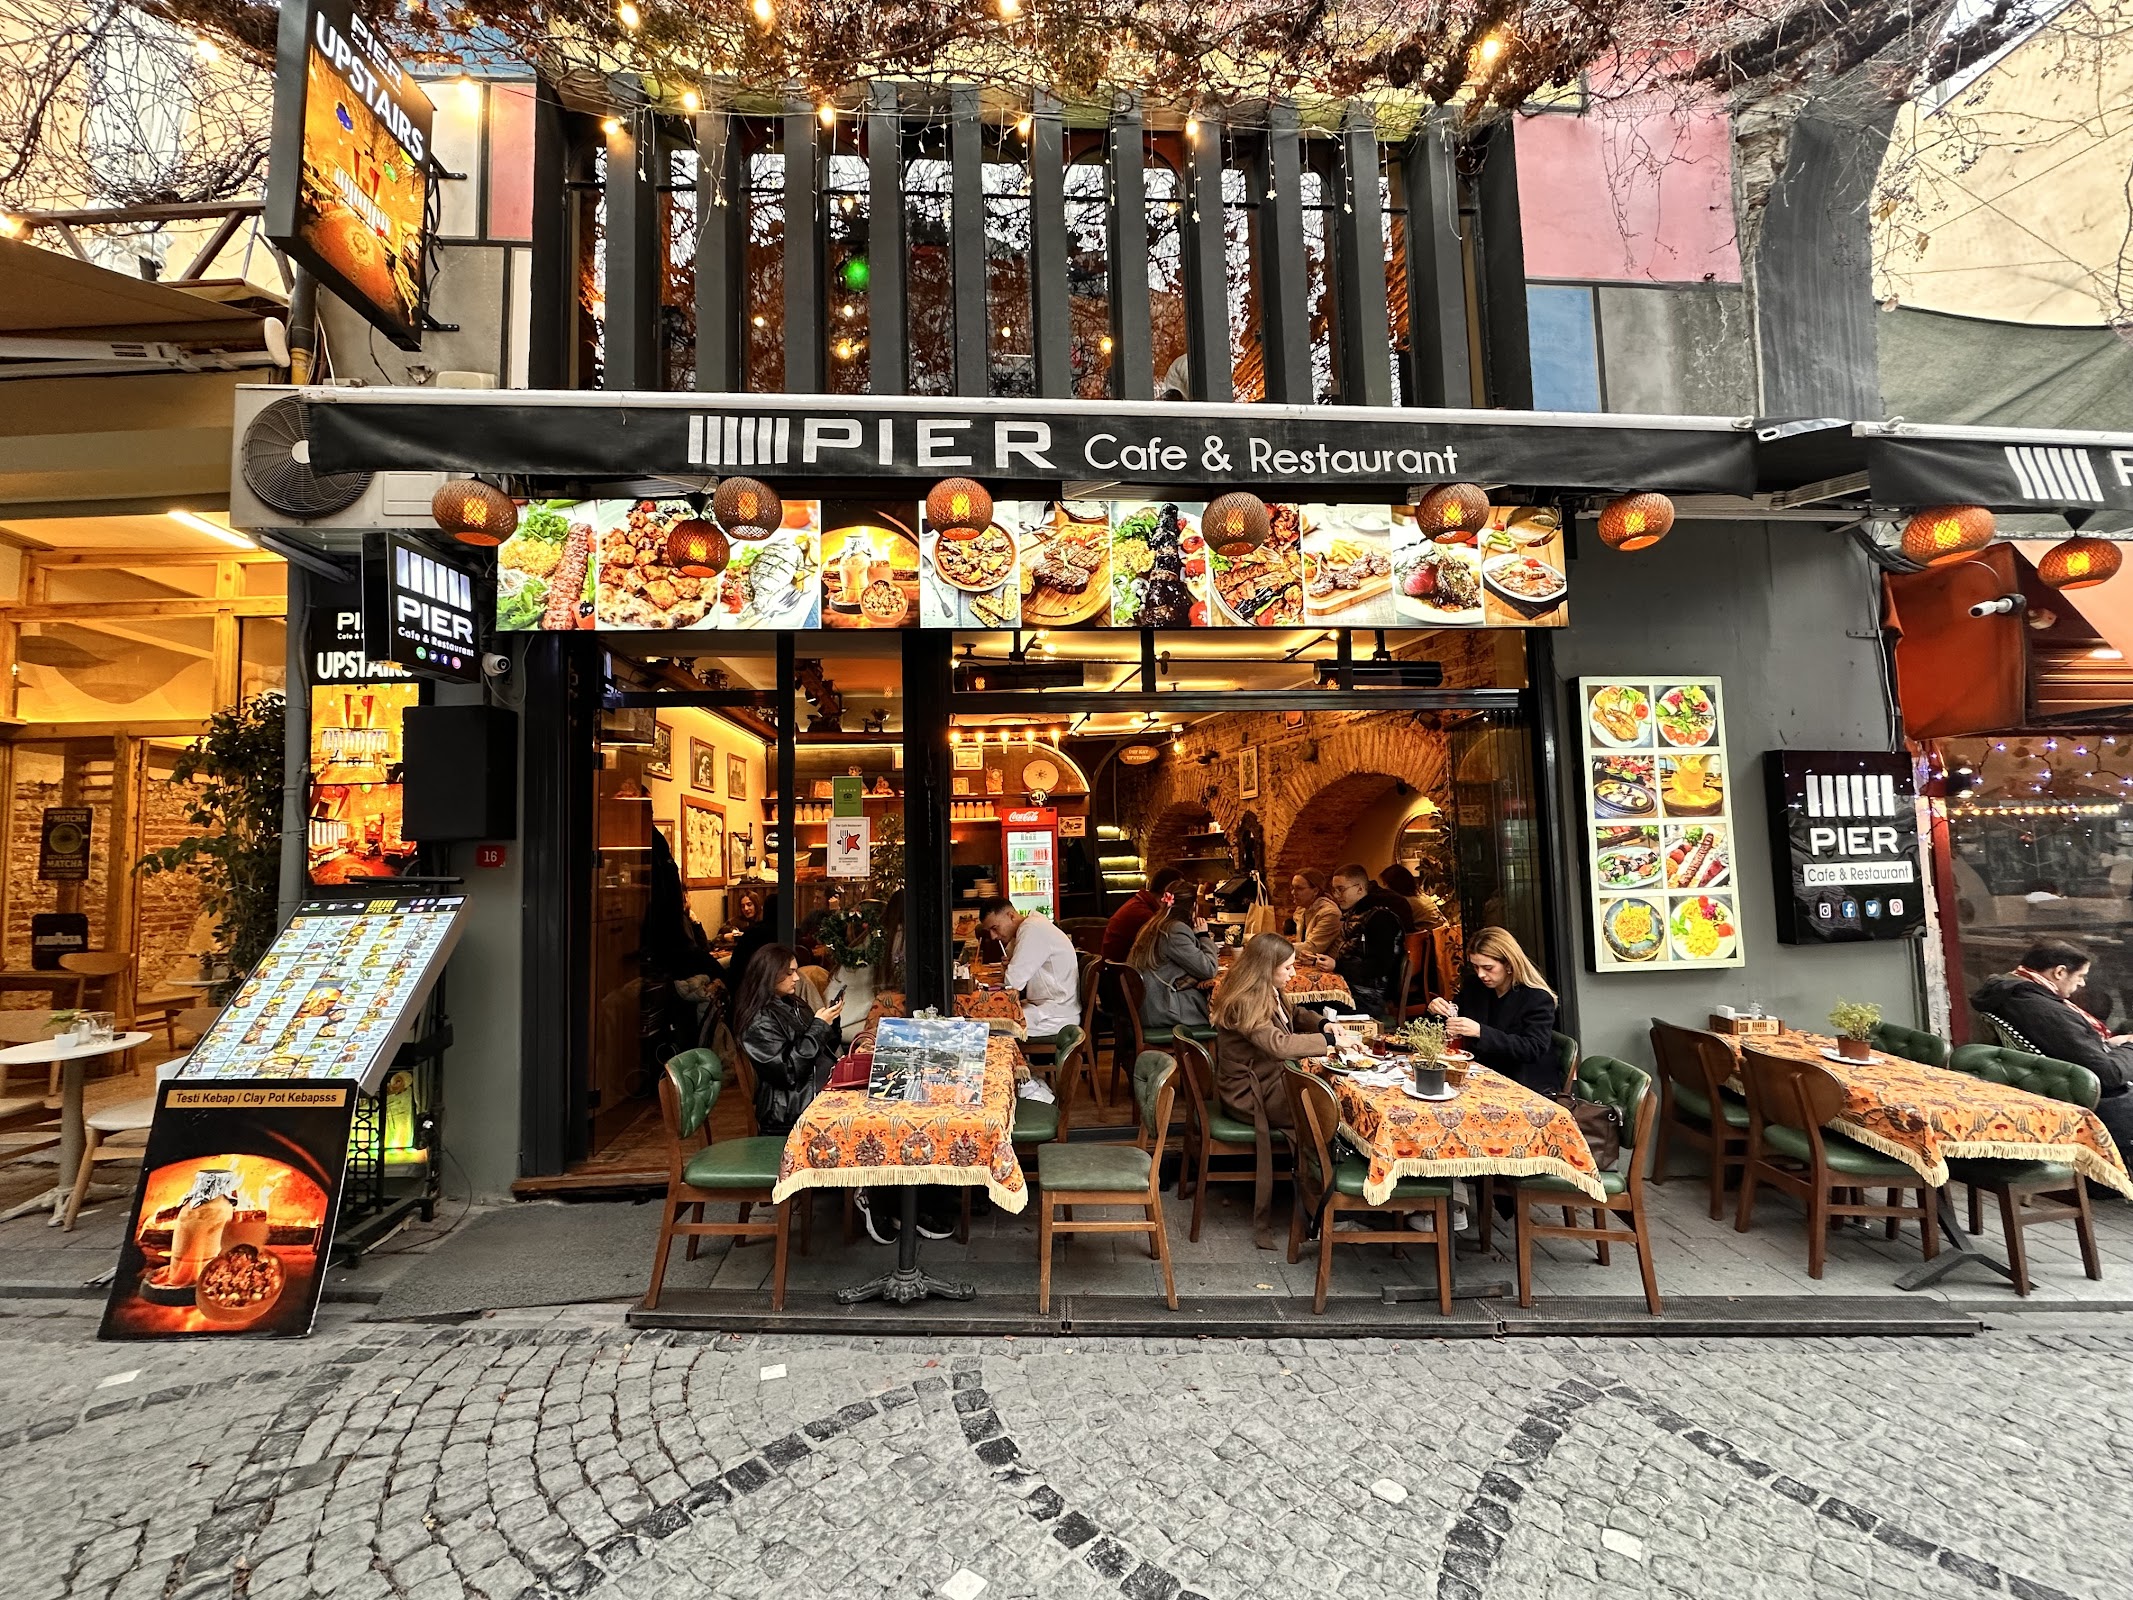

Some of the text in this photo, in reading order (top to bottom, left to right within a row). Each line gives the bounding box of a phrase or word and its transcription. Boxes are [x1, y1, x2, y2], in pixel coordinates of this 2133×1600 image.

[351, 12, 403, 88] PIER
[315, 10, 424, 162] UPSTAIRS
[803, 418, 1459, 475] PIER Cafe & Restaurant
[337, 611, 365, 631] PI
[397, 594, 474, 644] PIER
[337, 632, 353, 640] Cafe
[397, 626, 475, 657] Cafe & Restaurant
[317, 650, 413, 680] UPSTA
[1809, 826, 1900, 856] PIER
[46, 860, 83, 868] MATCHA
[484, 850, 498, 863] 16
[1807, 865, 1909, 882] Cafe & Restaurant
[176, 1092, 337, 1105] Testi Kebap / Clay Pot Kebapsss
